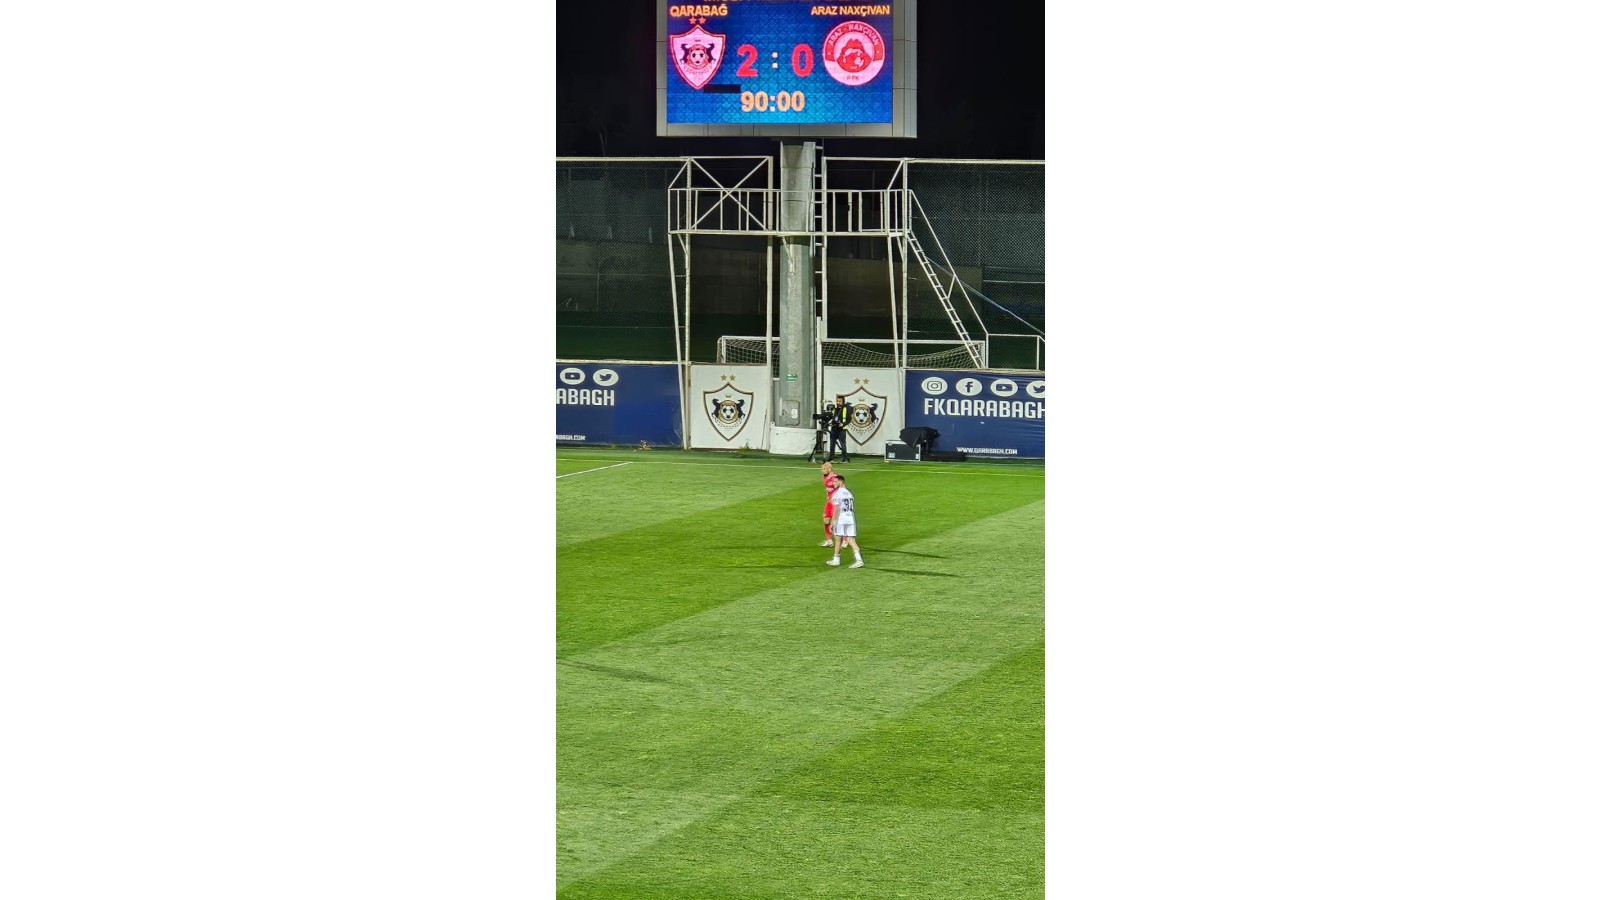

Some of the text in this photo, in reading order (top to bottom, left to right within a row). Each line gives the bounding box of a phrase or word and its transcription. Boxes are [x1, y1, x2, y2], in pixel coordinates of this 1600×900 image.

[669, 4, 728, 17] QARABAĞ
[811, 5, 890, 17] ARAZ NAXÇIVAN
[828, 28, 843, 46] ARAZ
[736, 43, 758, 77] 2
[791, 43, 814, 77] 0
[740, 90, 805, 112] 90:00
[556, 388, 615, 406] ABAGH
[924, 397, 1045, 418] FKQARABAGH
